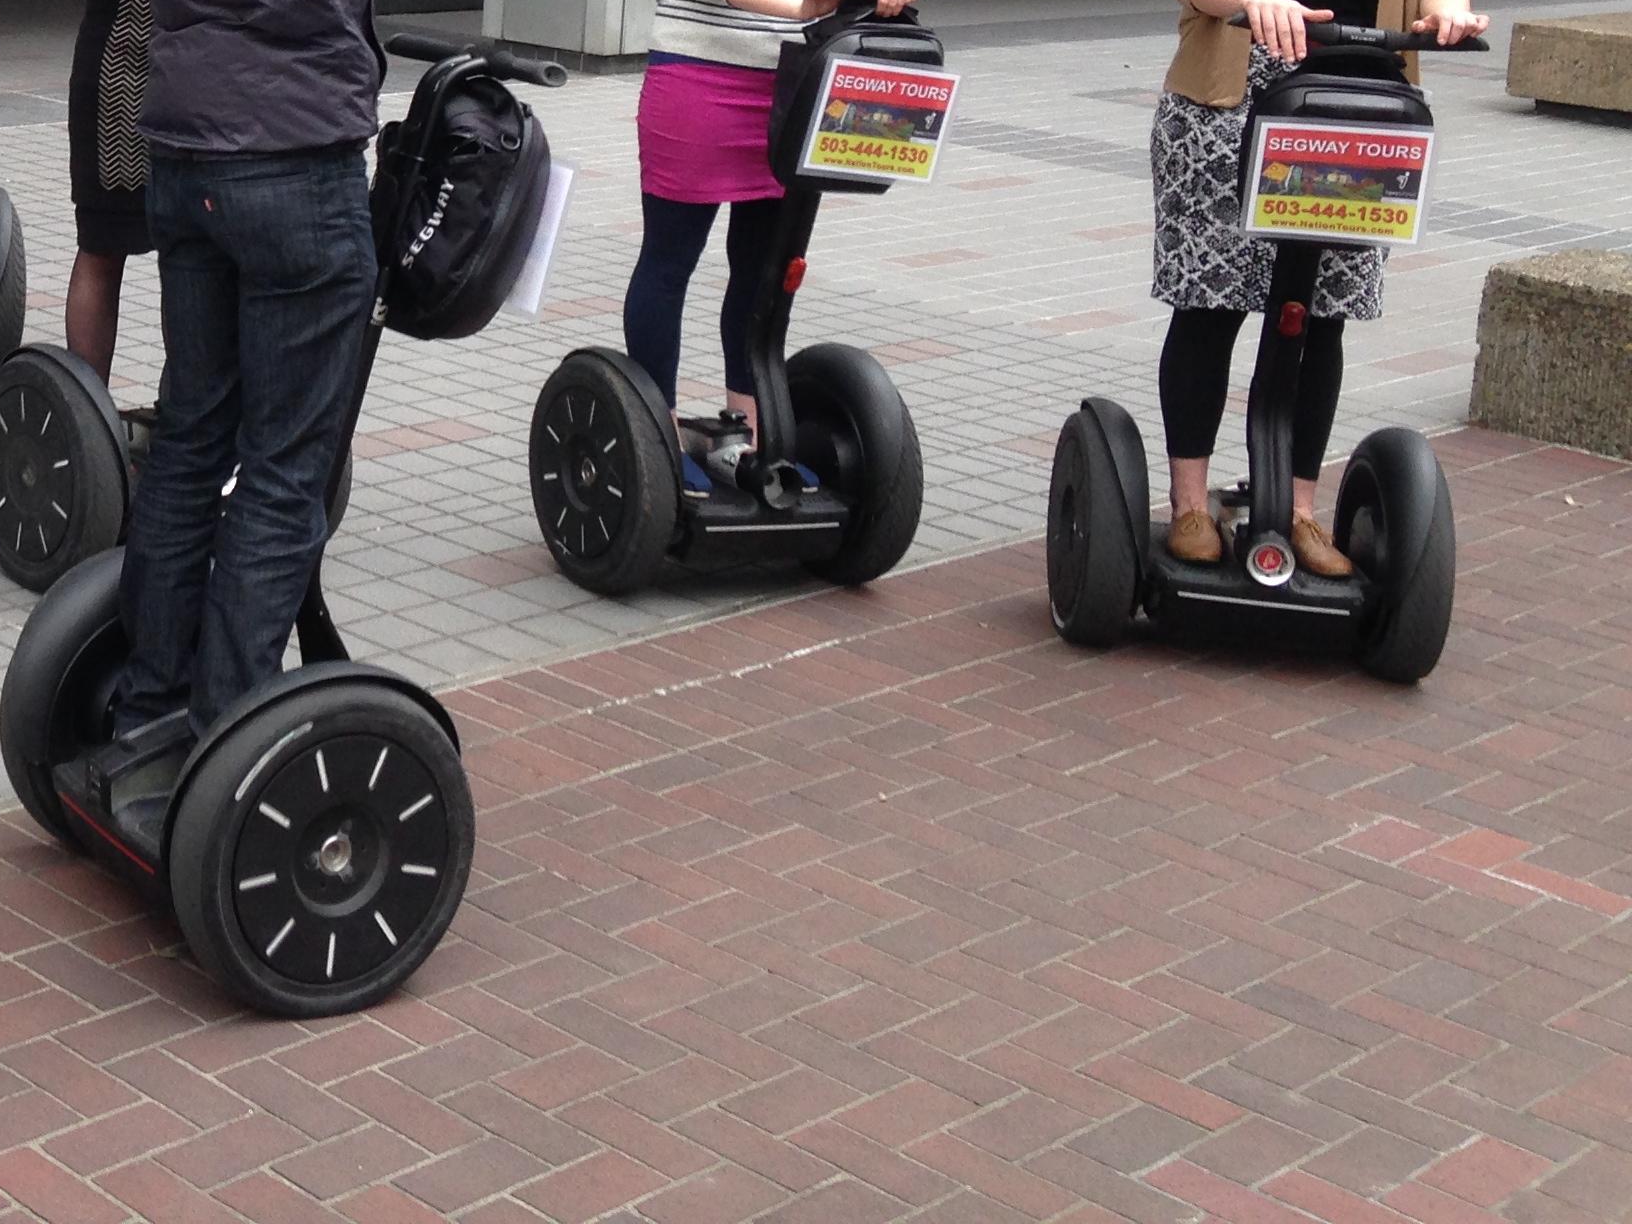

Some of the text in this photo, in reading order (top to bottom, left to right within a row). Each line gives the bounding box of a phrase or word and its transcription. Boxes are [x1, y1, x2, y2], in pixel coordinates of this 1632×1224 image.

[834, 74, 950, 102] SEGWAY TOURS
[819, 137, 928, 164] 503-444-1530
[1268, 137, 1423, 160] SEGWAY TOURS
[401, 177, 455, 270] SEGWAY
[1263, 199, 1409, 225] 503-444-1530
